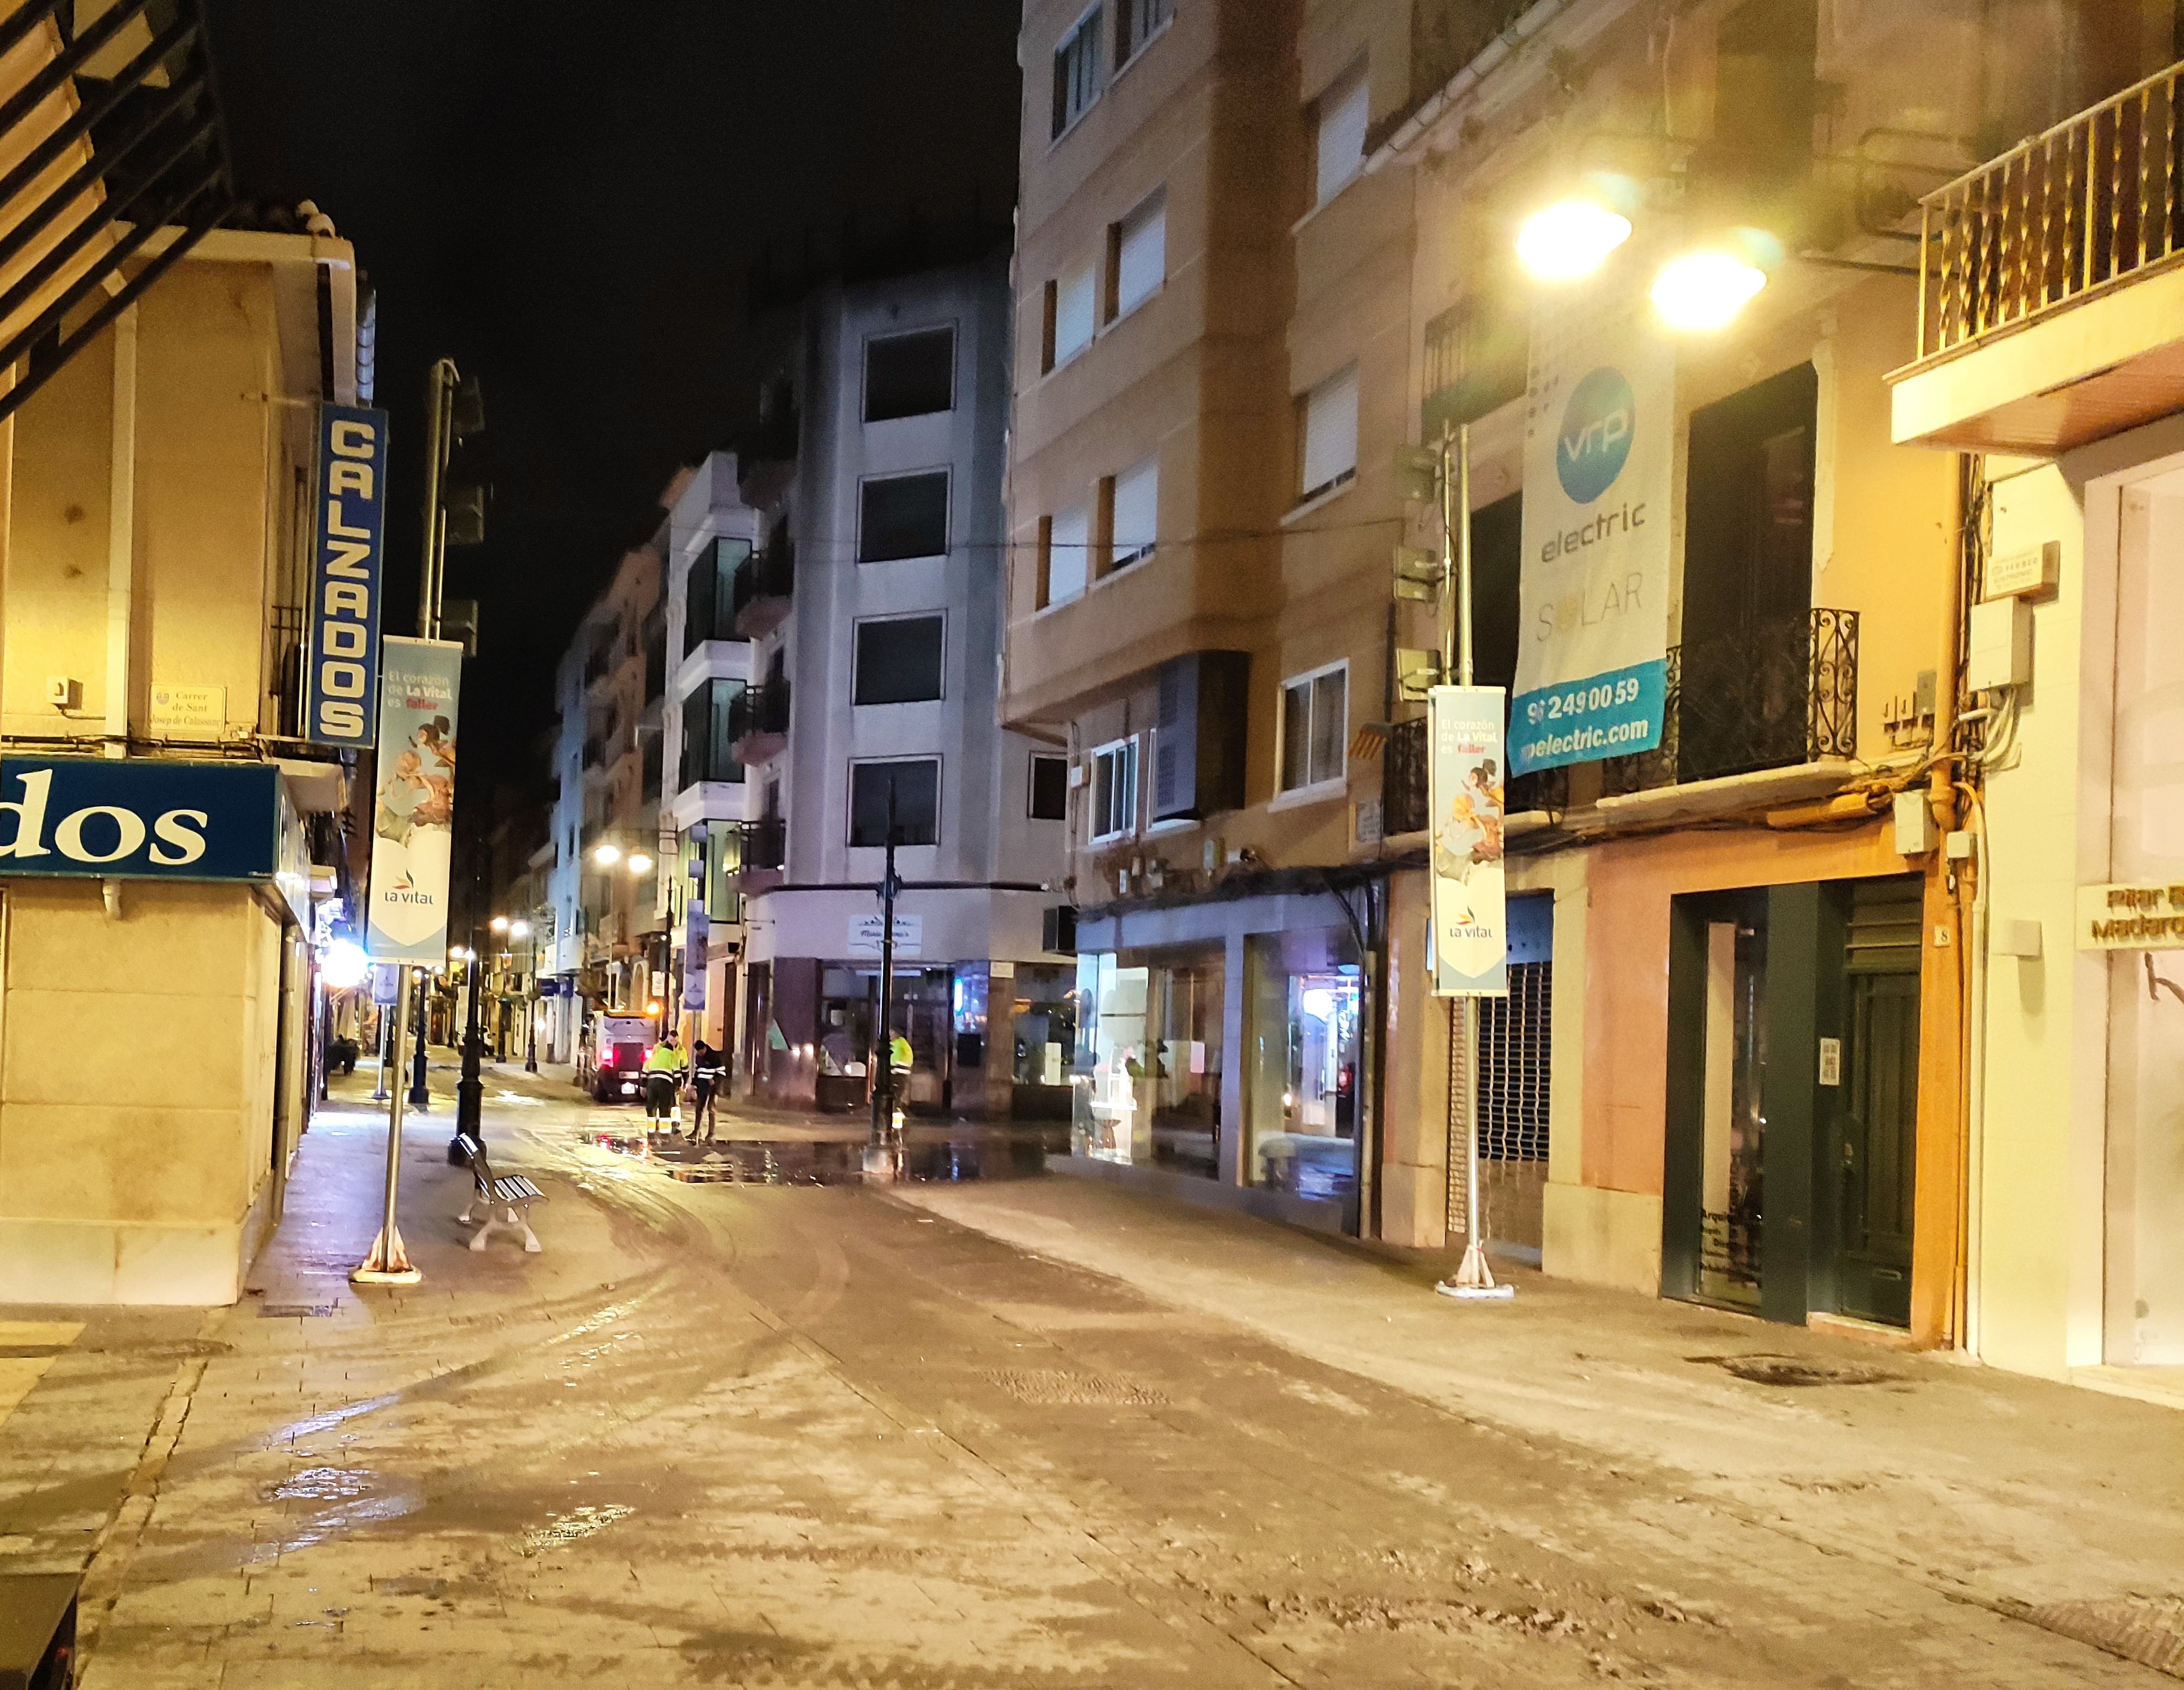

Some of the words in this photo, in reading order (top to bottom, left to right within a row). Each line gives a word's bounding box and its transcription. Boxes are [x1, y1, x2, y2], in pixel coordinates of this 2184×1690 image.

[1564, 409, 1628, 462] vrp
[1541, 502, 1646, 562] electric
[319, 419, 376, 738] CALZADOS
[389, 671, 399, 681] El
[176, 691, 208, 700] Carrer
[406, 685, 421, 696] La
[387, 698, 401, 708] es
[406, 698, 438, 710] faller
[1548, 692, 1586, 719] 249
[1588, 684, 1612, 711] 00
[1615, 678, 1639, 705] 59
[186, 704, 207, 712] Sant
[151, 714, 171, 726] Josep
[173, 716, 181, 724] de
[1442, 719, 1451, 729] El
[1442, 731, 1454, 741] de
[1457, 732, 1470, 742] La
[1441, 745, 1452, 754] es
[2106, 888, 2166, 911] Pilar
[1941, 930, 1948, 942] 8
